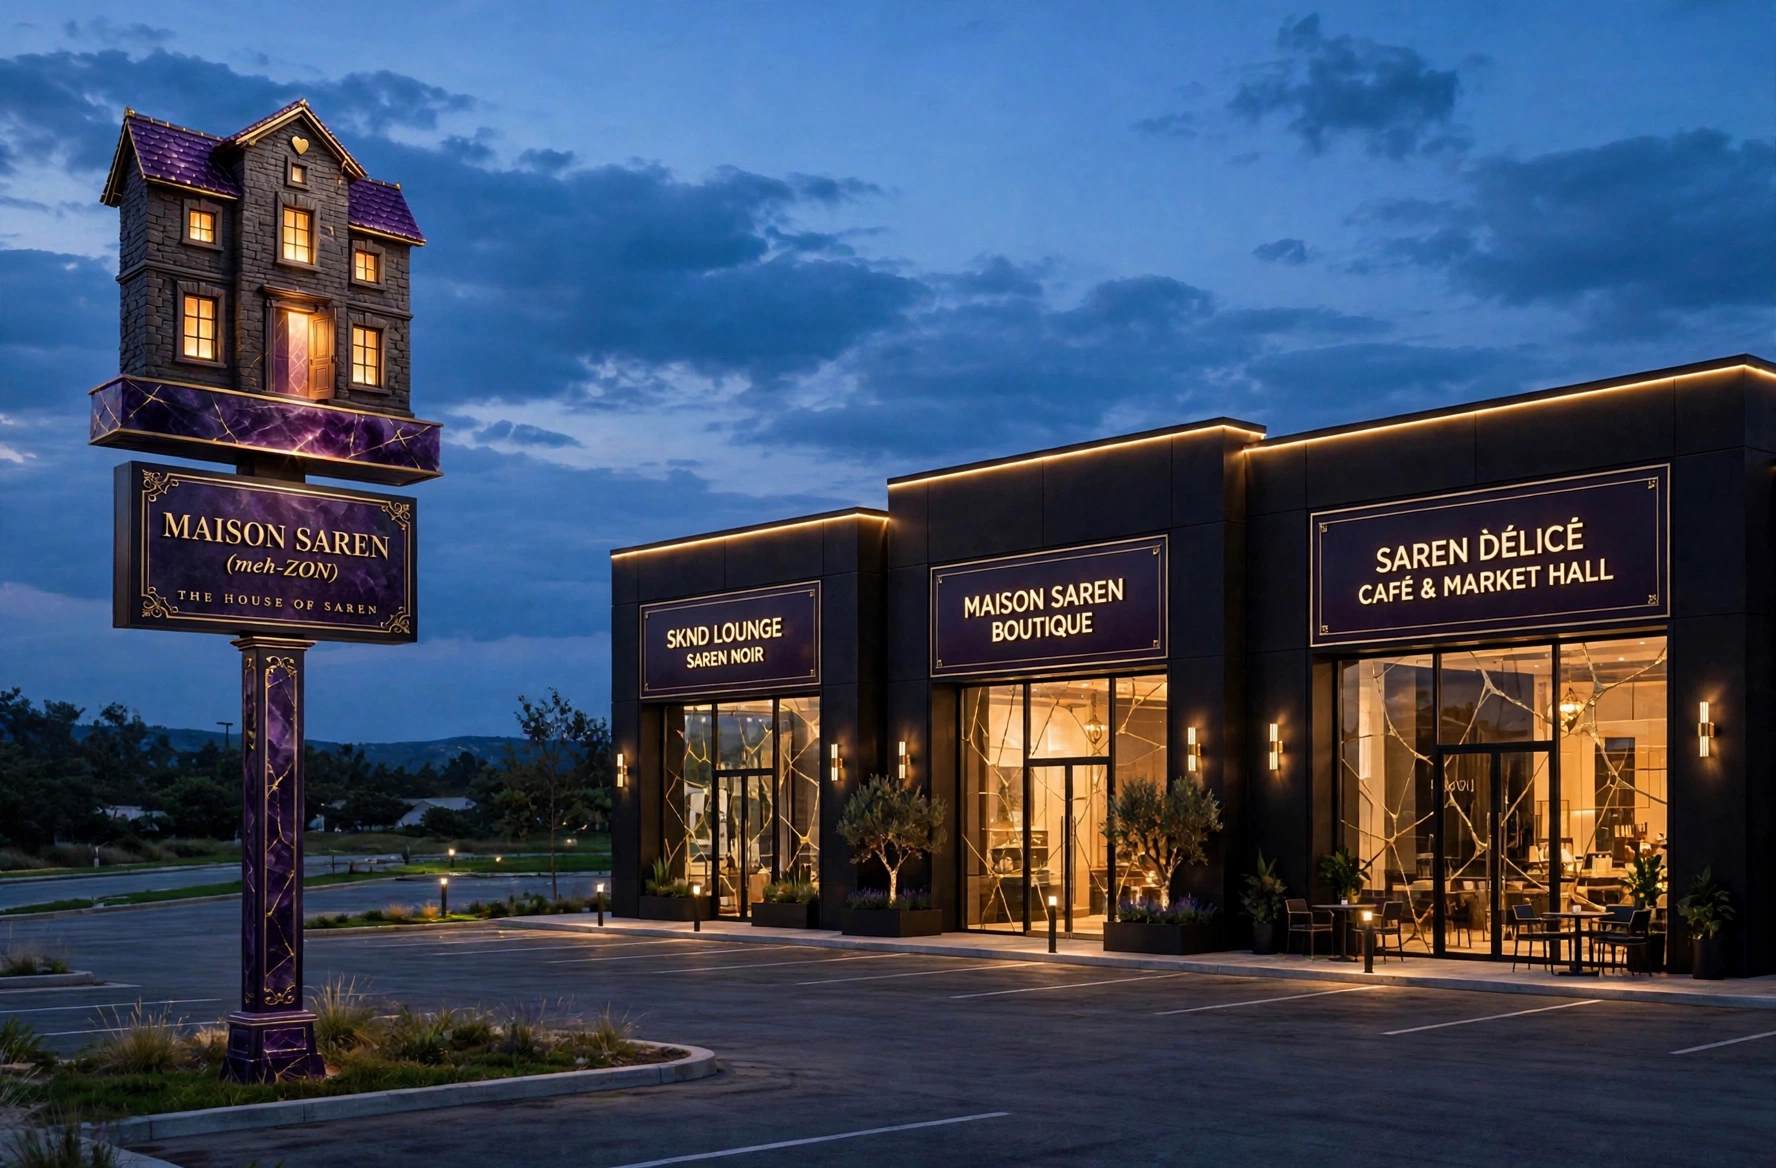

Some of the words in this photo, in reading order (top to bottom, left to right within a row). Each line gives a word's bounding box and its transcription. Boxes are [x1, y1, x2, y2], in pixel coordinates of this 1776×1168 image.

[163, 512, 285, 549] MAISON
[296, 527, 390, 560] SAREN
[227, 553, 339, 583] (meh-ZON)
[1375, 537, 1468, 574] SAREN
[964, 587, 1044, 618] MAISON
[1050, 577, 1123, 609] SAREN
[1358, 575, 1414, 605] CAFÉ
[1420, 577, 1437, 599] &
[1443, 565, 1541, 597] MARKET
[1548, 558, 1614, 586] HALL
[177, 590, 212, 603] THE
[224, 593, 283, 608] HOUSE
[293, 598, 314, 611] OF
[324, 601, 378, 615] SAREN
[666, 626, 710, 649] SKND
[713, 617, 782, 644] LOUNGE
[992, 611, 1093, 643] BOUTIQUE
[686, 650, 728, 669] SAREN
[730, 646, 764, 665] NOIR
